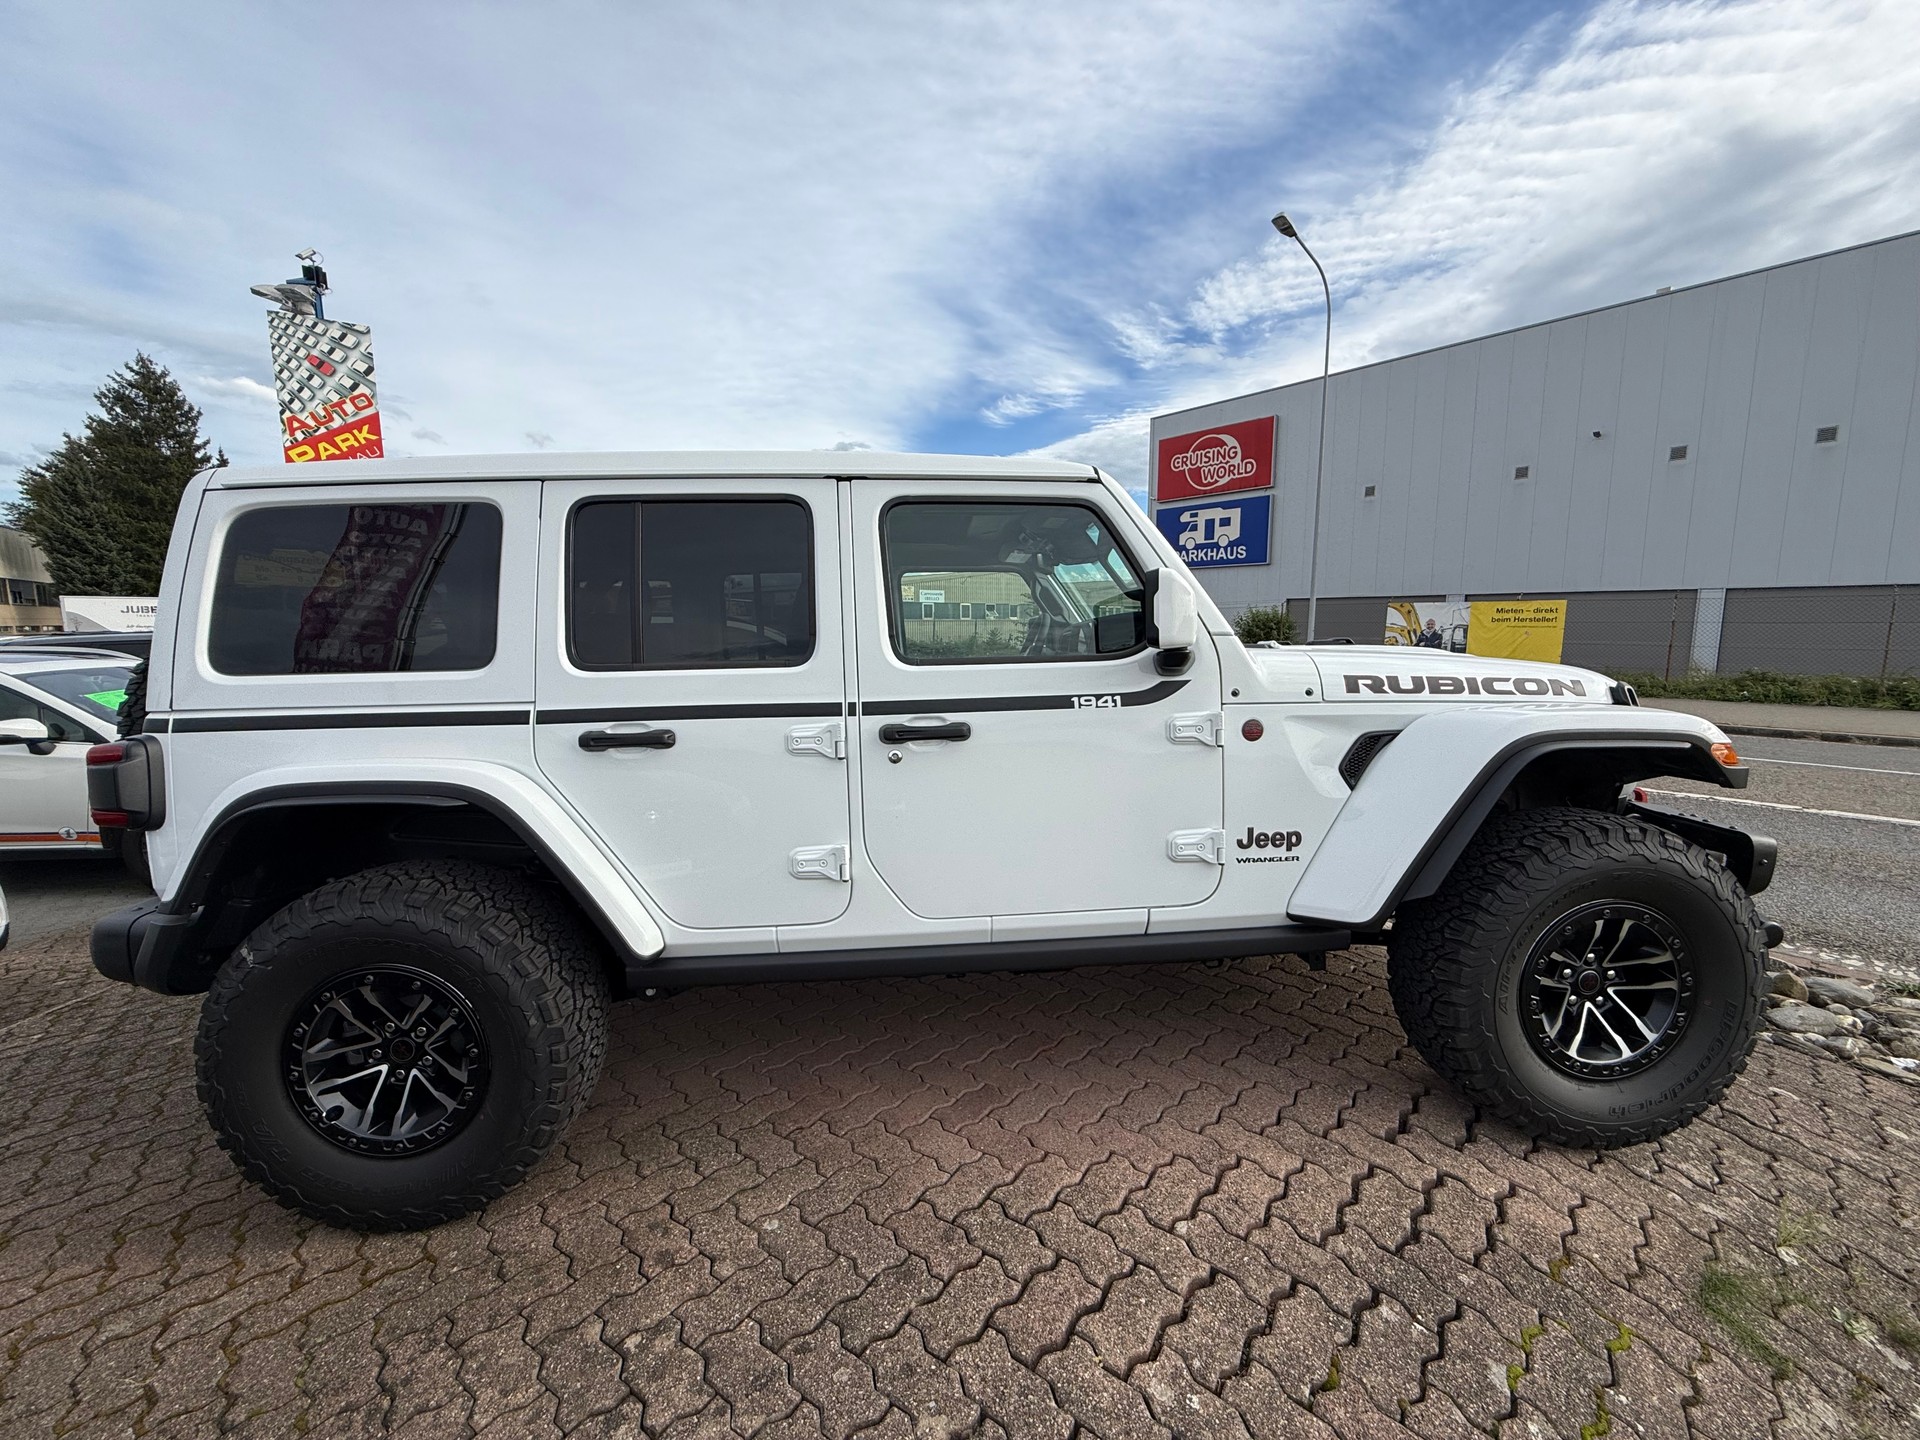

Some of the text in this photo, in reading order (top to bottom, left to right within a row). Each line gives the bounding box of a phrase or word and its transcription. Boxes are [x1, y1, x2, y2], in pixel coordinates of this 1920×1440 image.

[285, 392, 375, 438] AUTO
[287, 423, 380, 463] PARK
[1172, 445, 1238, 470] CRUISING
[1202, 460, 1255, 482] WORLD
[1343, 674, 1587, 697] RUBICON
[1070, 695, 1122, 709] 1941
[1236, 826, 1303, 852] Jeep
[1235, 855, 1301, 865] WRANGLER
